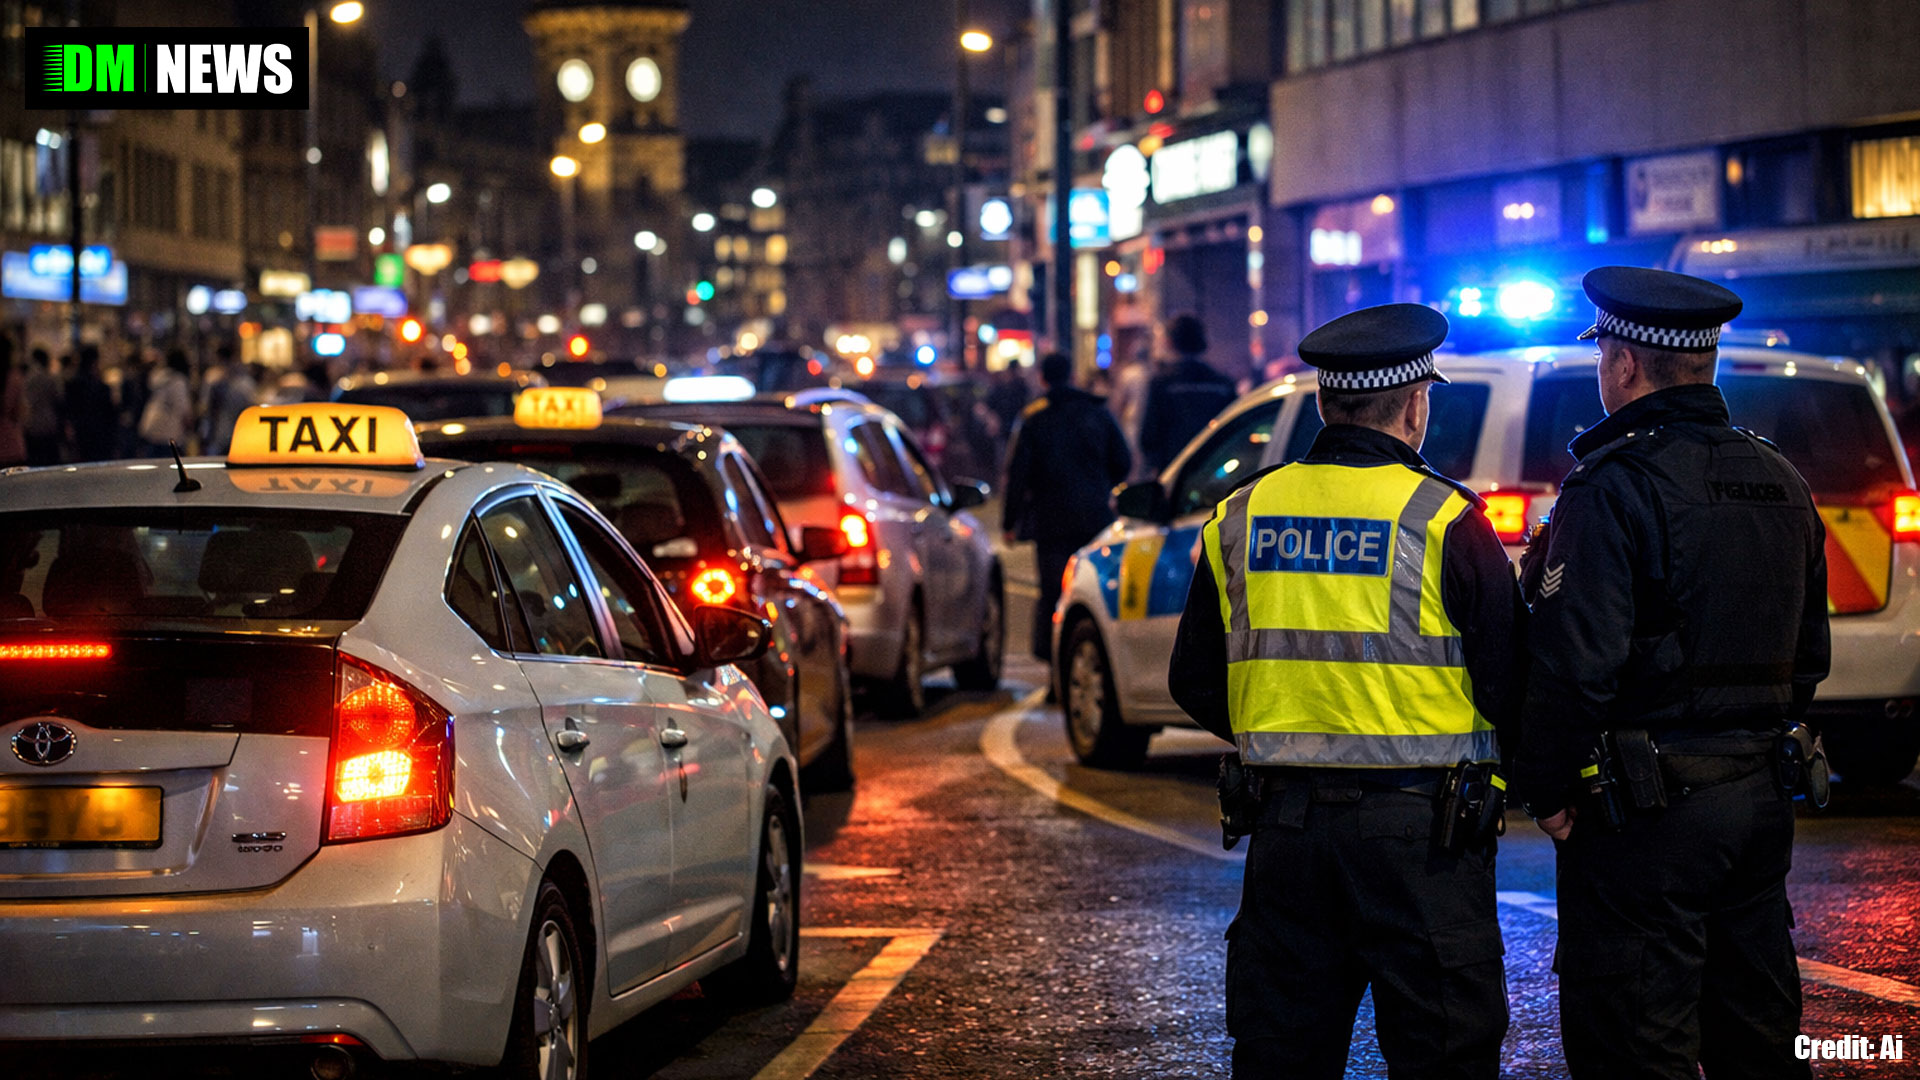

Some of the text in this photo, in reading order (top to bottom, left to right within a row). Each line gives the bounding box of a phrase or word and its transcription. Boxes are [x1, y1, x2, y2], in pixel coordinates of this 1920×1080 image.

[531, 395, 586, 414] TAXI
[259, 416, 377, 453] TAXI
[1256, 528, 1382, 562] POLICE
